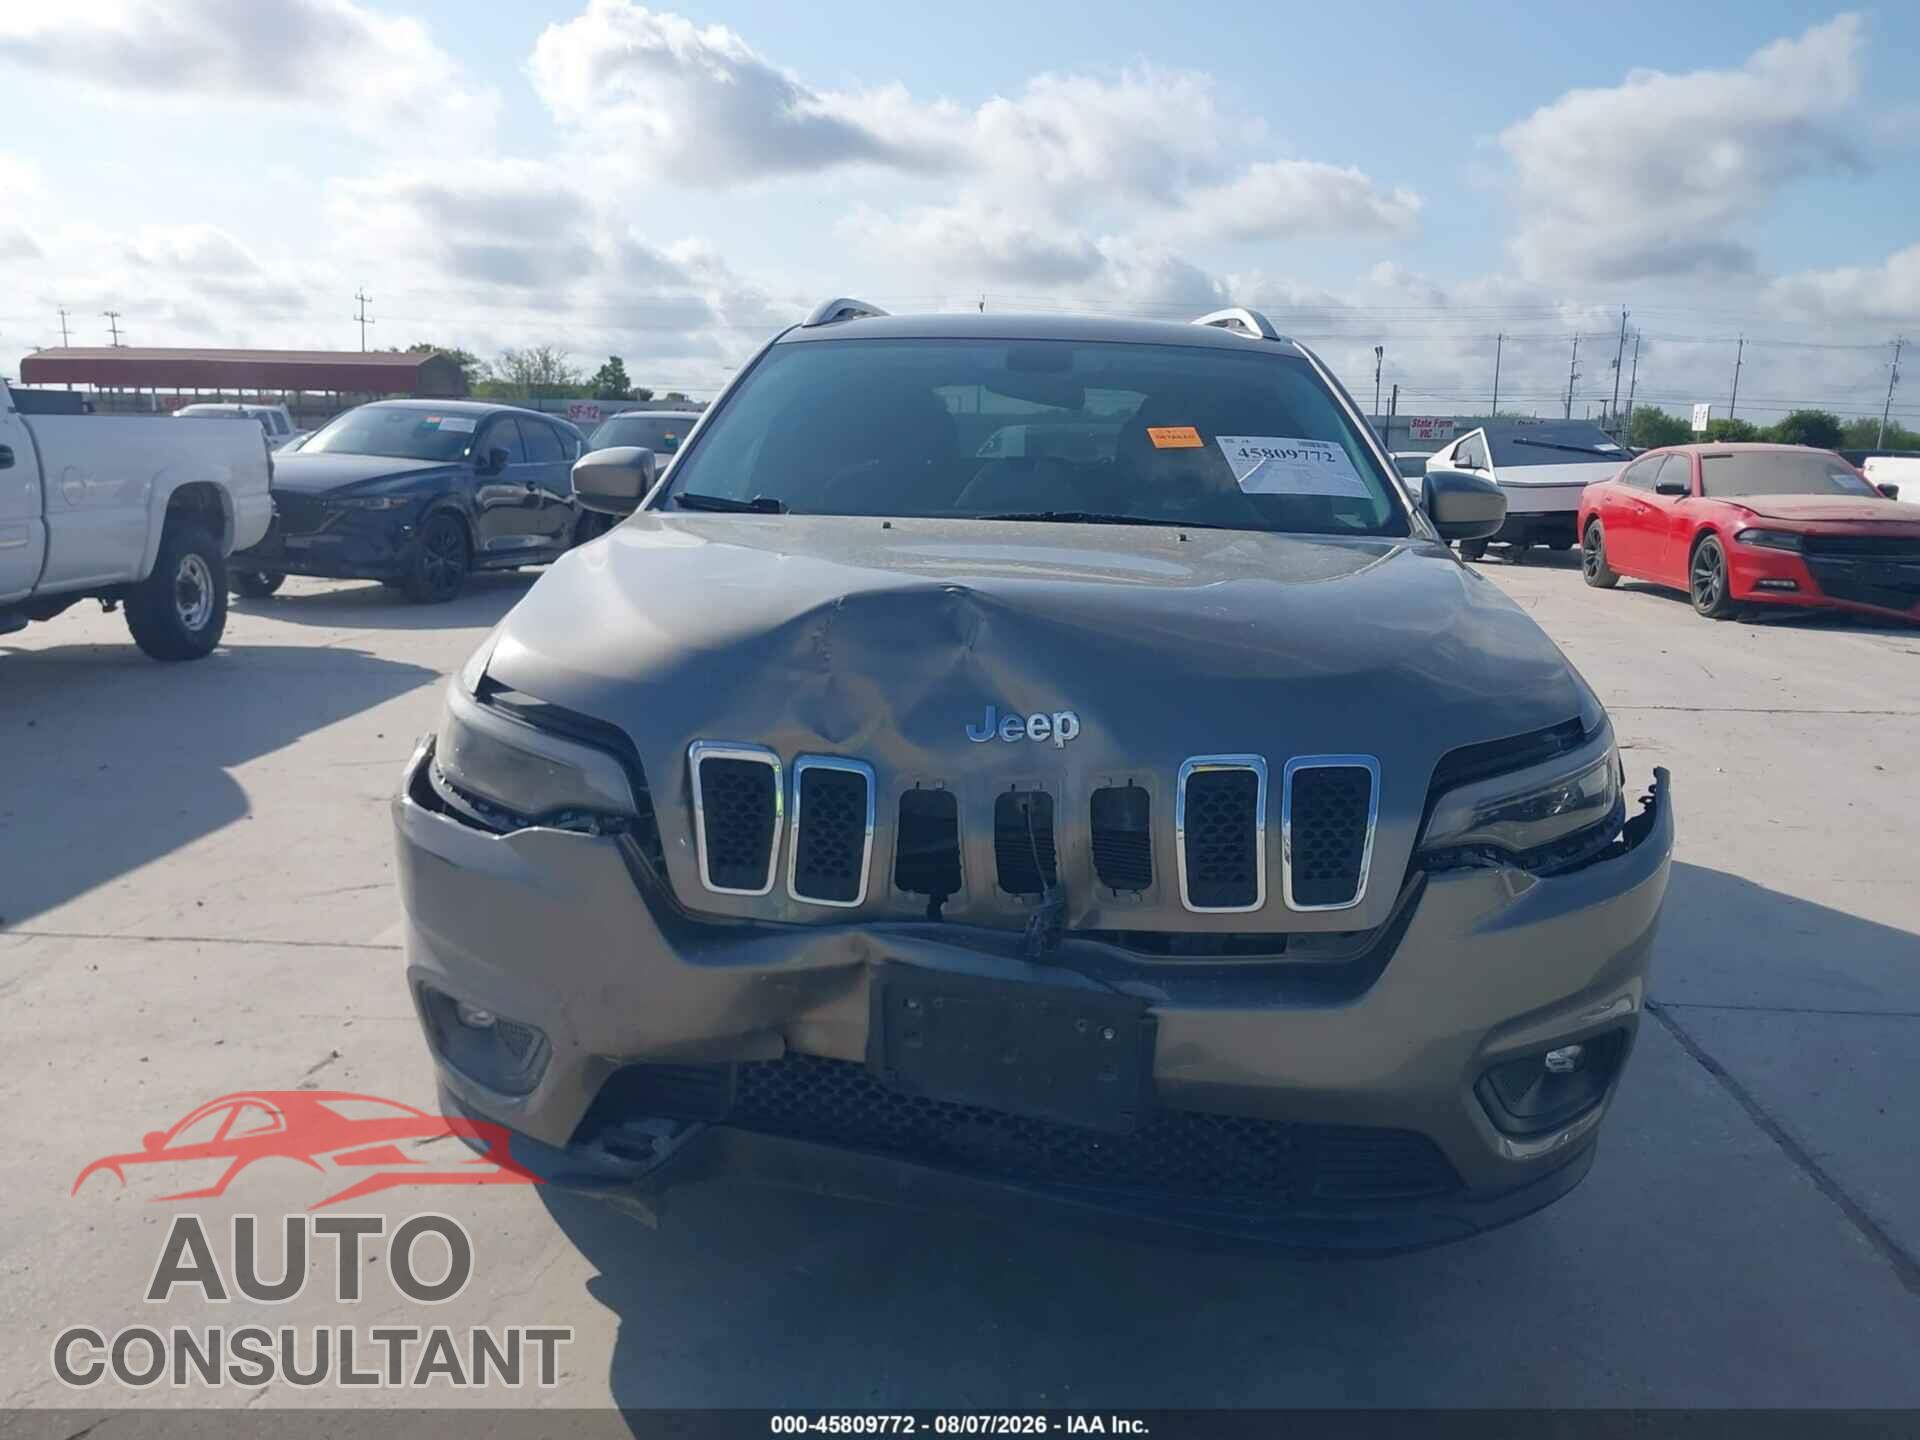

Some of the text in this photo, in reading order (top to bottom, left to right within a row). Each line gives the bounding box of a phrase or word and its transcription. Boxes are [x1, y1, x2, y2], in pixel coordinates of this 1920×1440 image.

[1411, 417, 1454, 428] State Farm
[1238, 447, 1336, 463] 45809772
[966, 704, 1080, 749] Jeep
